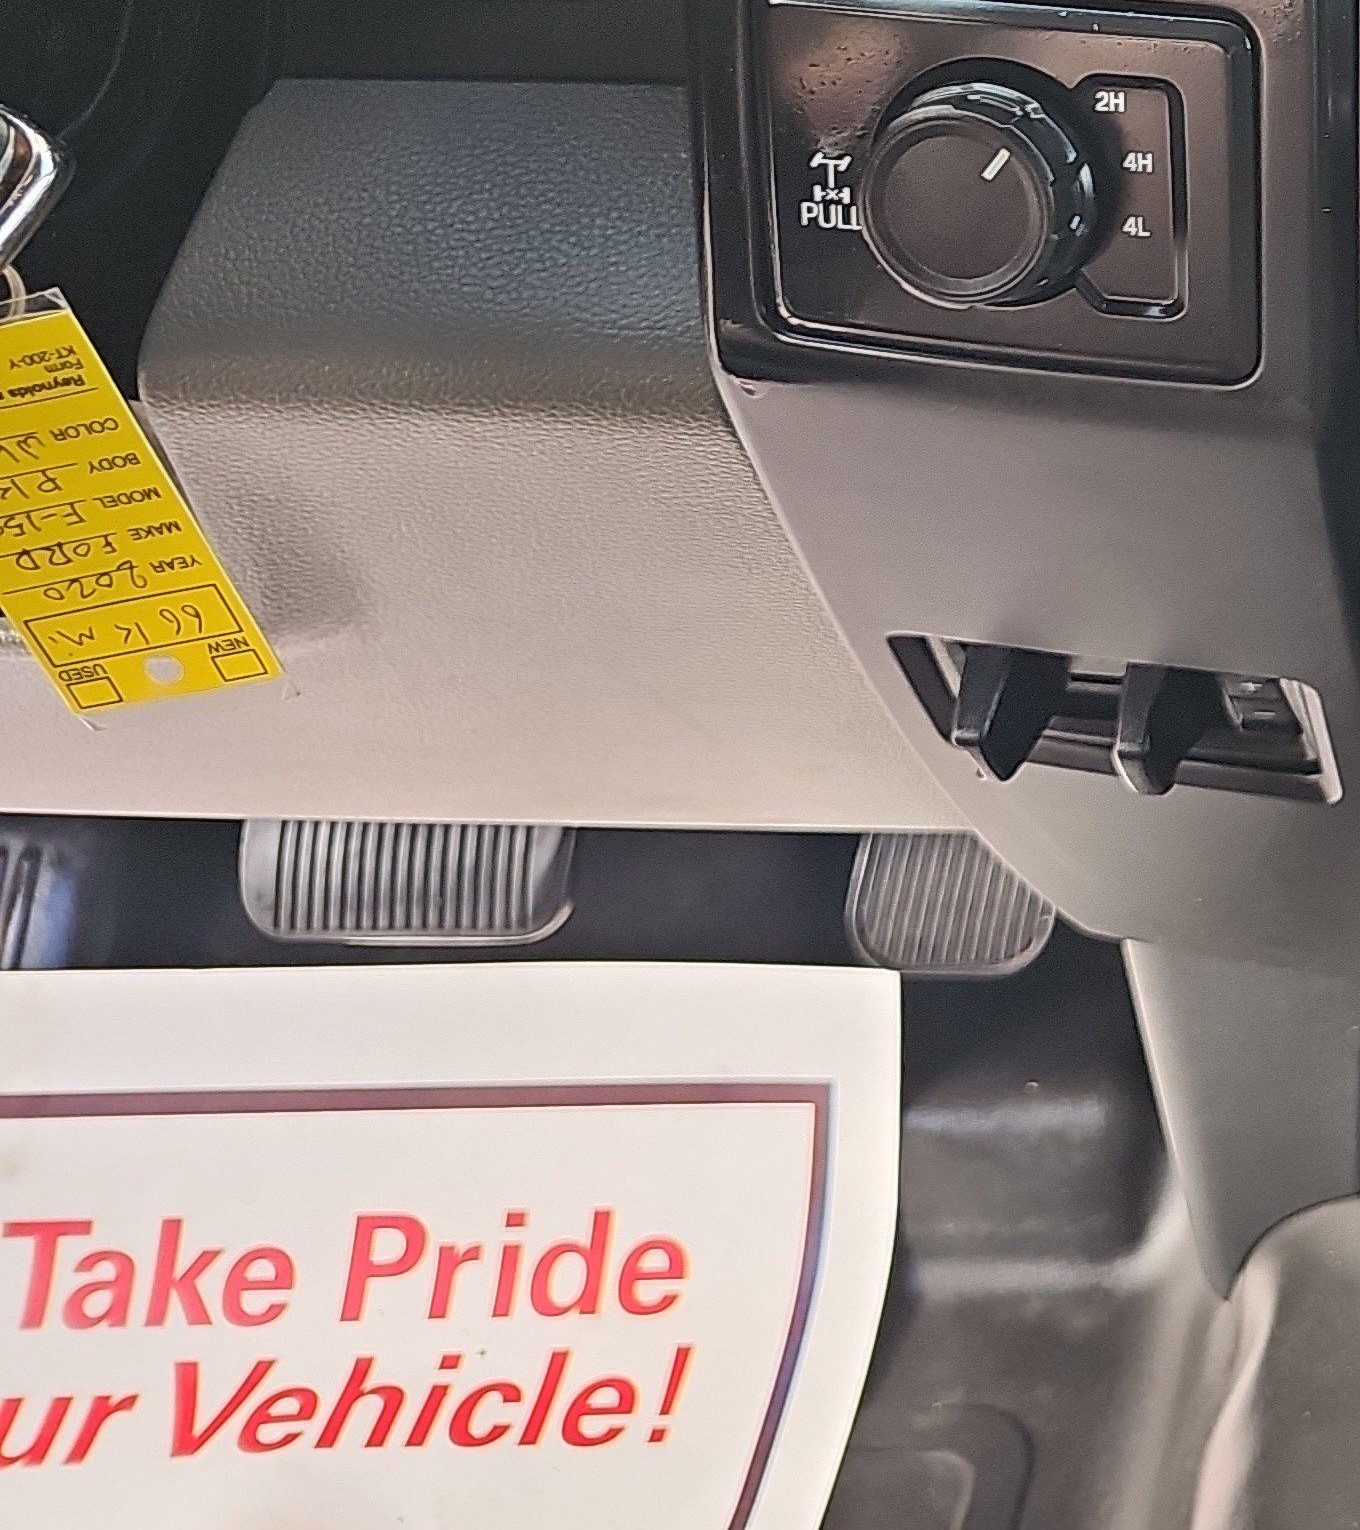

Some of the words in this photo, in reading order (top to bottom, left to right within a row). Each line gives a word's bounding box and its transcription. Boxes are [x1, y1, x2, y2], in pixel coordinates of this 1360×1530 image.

[1094, 90, 1126, 113] 2H
[1122, 151, 1154, 174] 4H
[801, 202, 863, 230] PULL
[1121, 217, 1151, 238] 4L
[9, 344, 77, 370] KT-200-Y
[43, 357, 85, 374] Form
[6, 374, 87, 399] Reynolds
[49, 417, 119, 442] COLOR
[88, 452, 142, 475] BODY
[92, 486, 163, 509] MODEL
[127, 520, 183, 541] MAKE
[15, 534, 118, 571] FORD
[148, 554, 203, 574] YEAR
[43, 559, 149, 601] 2020
[158, 604, 203, 636] 66
[207, 636, 250, 655] NEW
[58, 663, 109, 682] USED
[1, 1216, 296, 1331] Take
[339, 1206, 690, 1325] Pride
[0, 1393, 140, 1468] ur
[170, 1344, 696, 1458] Vehicle!
